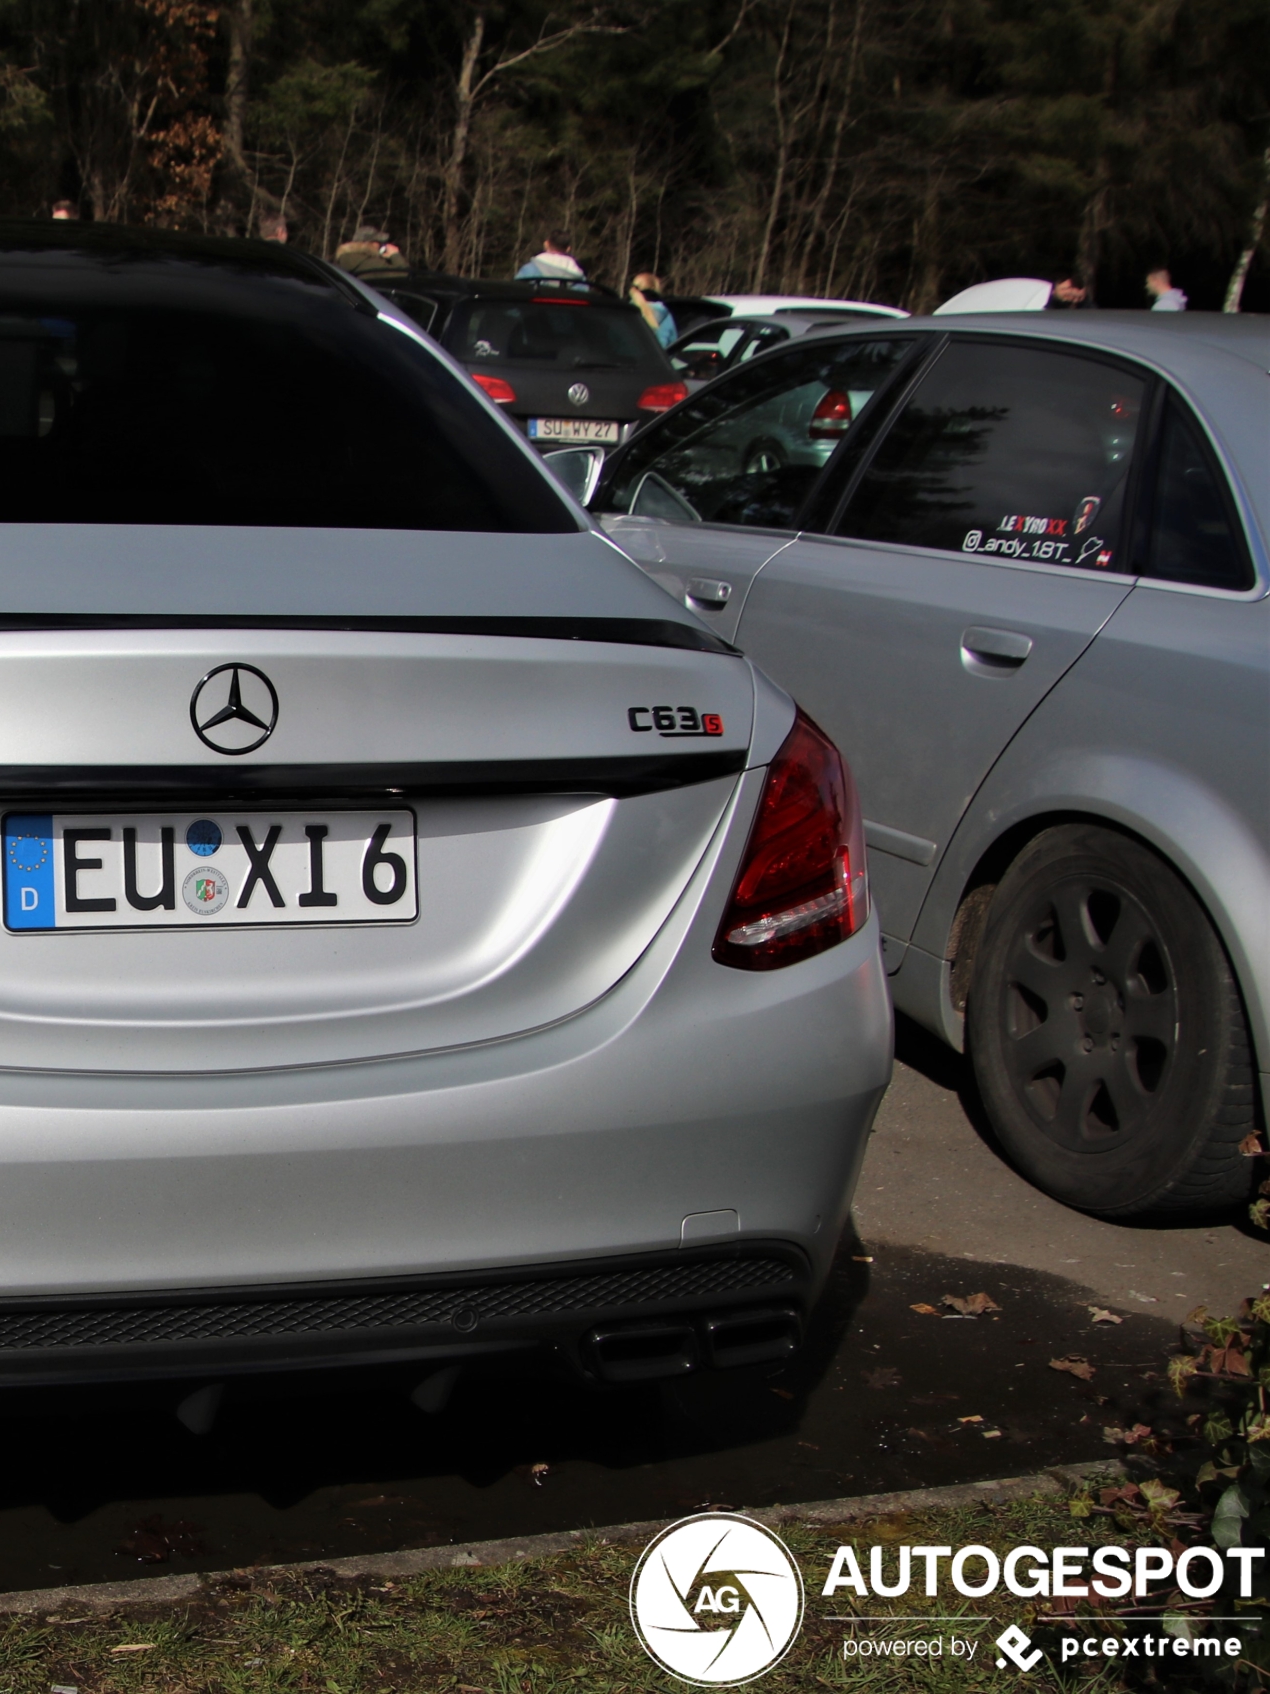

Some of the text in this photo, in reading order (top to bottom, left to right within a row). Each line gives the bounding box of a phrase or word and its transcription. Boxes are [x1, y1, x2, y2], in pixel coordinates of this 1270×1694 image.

[543, 420, 563, 436] SU
[594, 423, 611, 438] 27
[21, 887, 38, 911] D
[63, 827, 176, 913] EU
[236, 824, 338, 909] XI
[361, 823, 408, 905] 6
